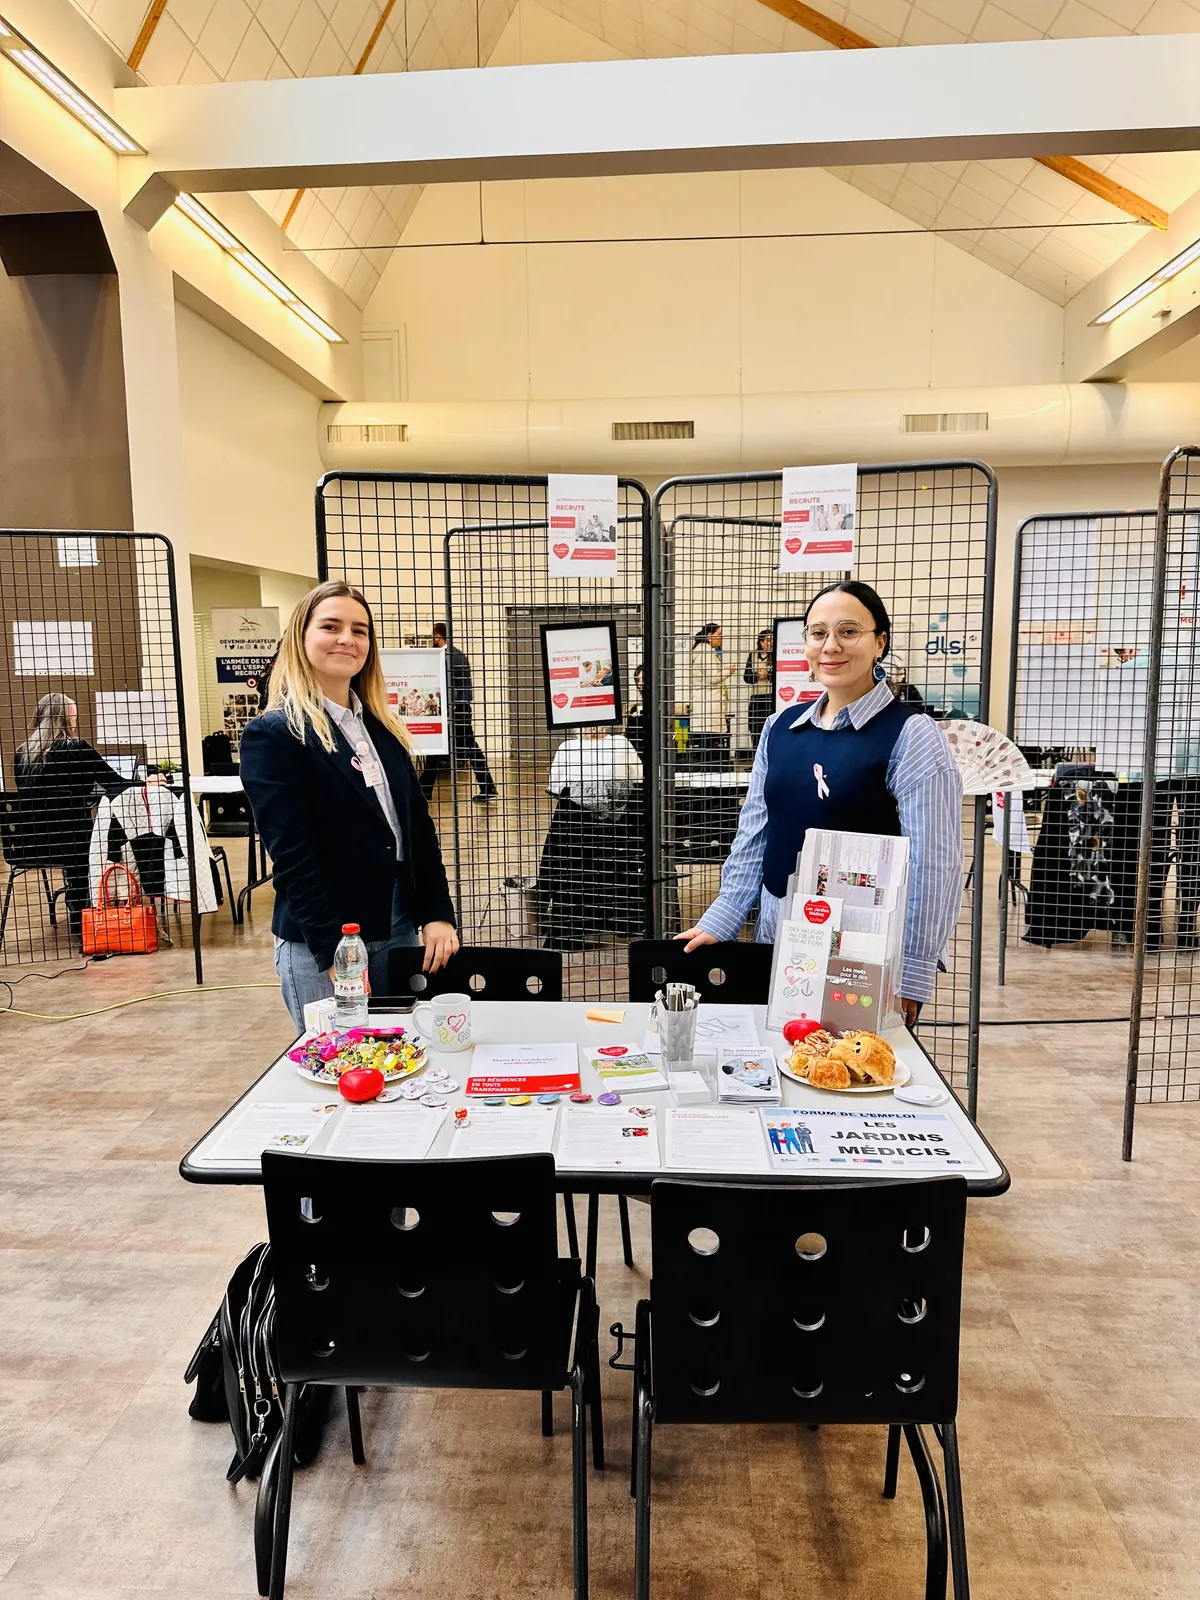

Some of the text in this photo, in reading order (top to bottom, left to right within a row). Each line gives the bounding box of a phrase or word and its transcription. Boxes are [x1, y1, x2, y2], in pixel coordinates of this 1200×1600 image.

[925, 635, 966, 655] dlsi
[830, 1131, 944, 1142] JARDINS
[838, 1145, 951, 1156] MÉDICIS
